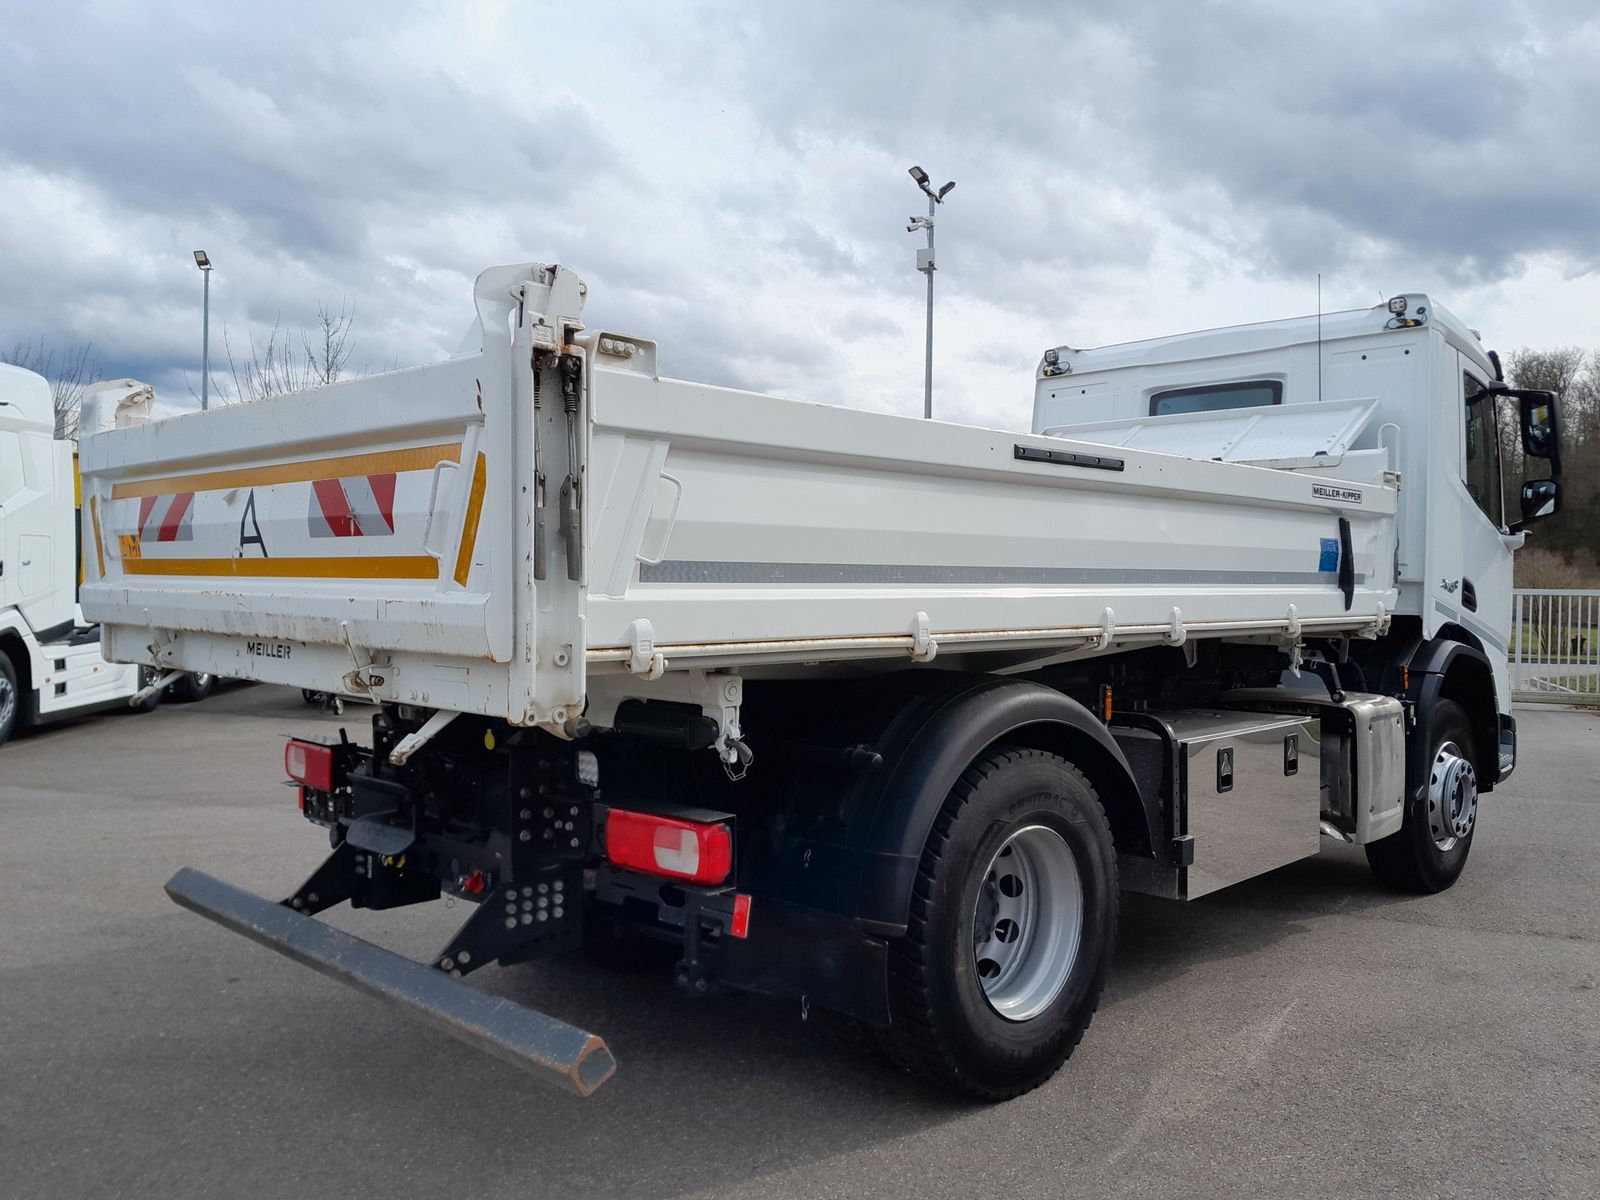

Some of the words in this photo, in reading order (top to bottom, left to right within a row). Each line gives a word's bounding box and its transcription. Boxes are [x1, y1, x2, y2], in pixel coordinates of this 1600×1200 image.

[1313, 486, 1361, 501] MEILLER-KIPPER
[240, 487, 269, 558] A
[246, 641, 291, 660] MEILLER
